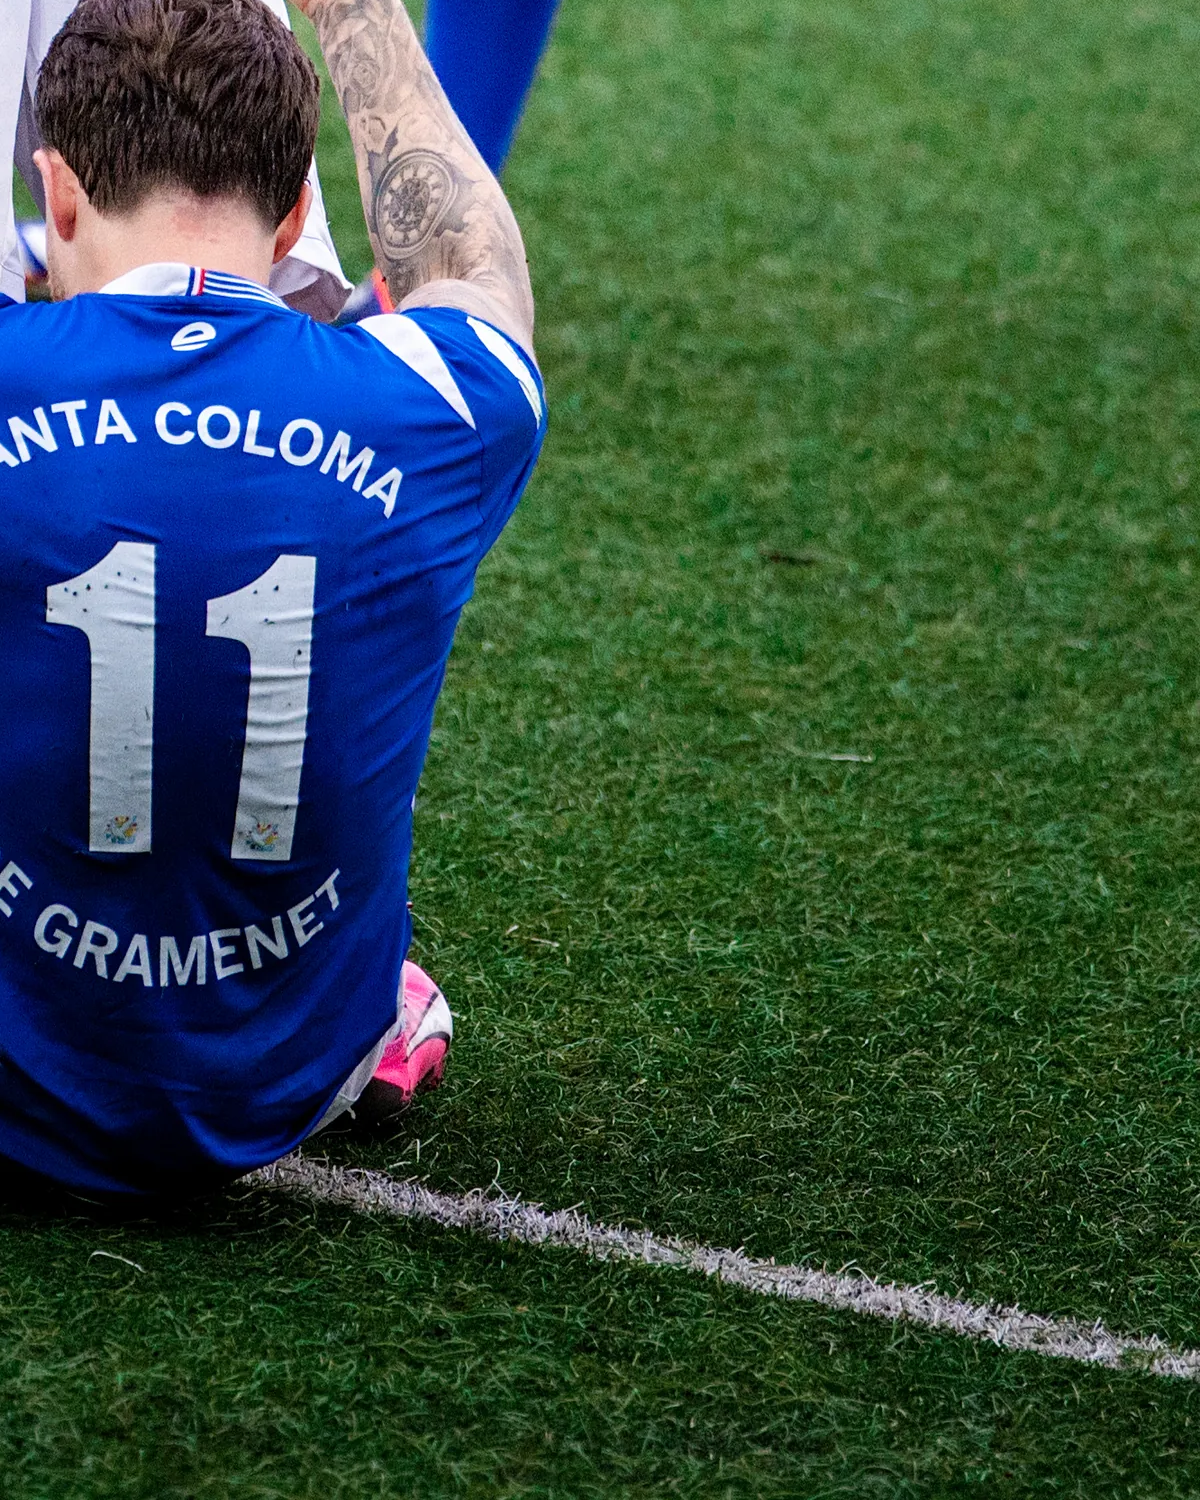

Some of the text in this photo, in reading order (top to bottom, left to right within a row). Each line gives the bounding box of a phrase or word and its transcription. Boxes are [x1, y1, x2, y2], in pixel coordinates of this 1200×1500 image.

[154, 401, 403, 519] COLOMA
[45, 540, 317, 861] 11
[33, 868, 341, 988] GRAMENET
